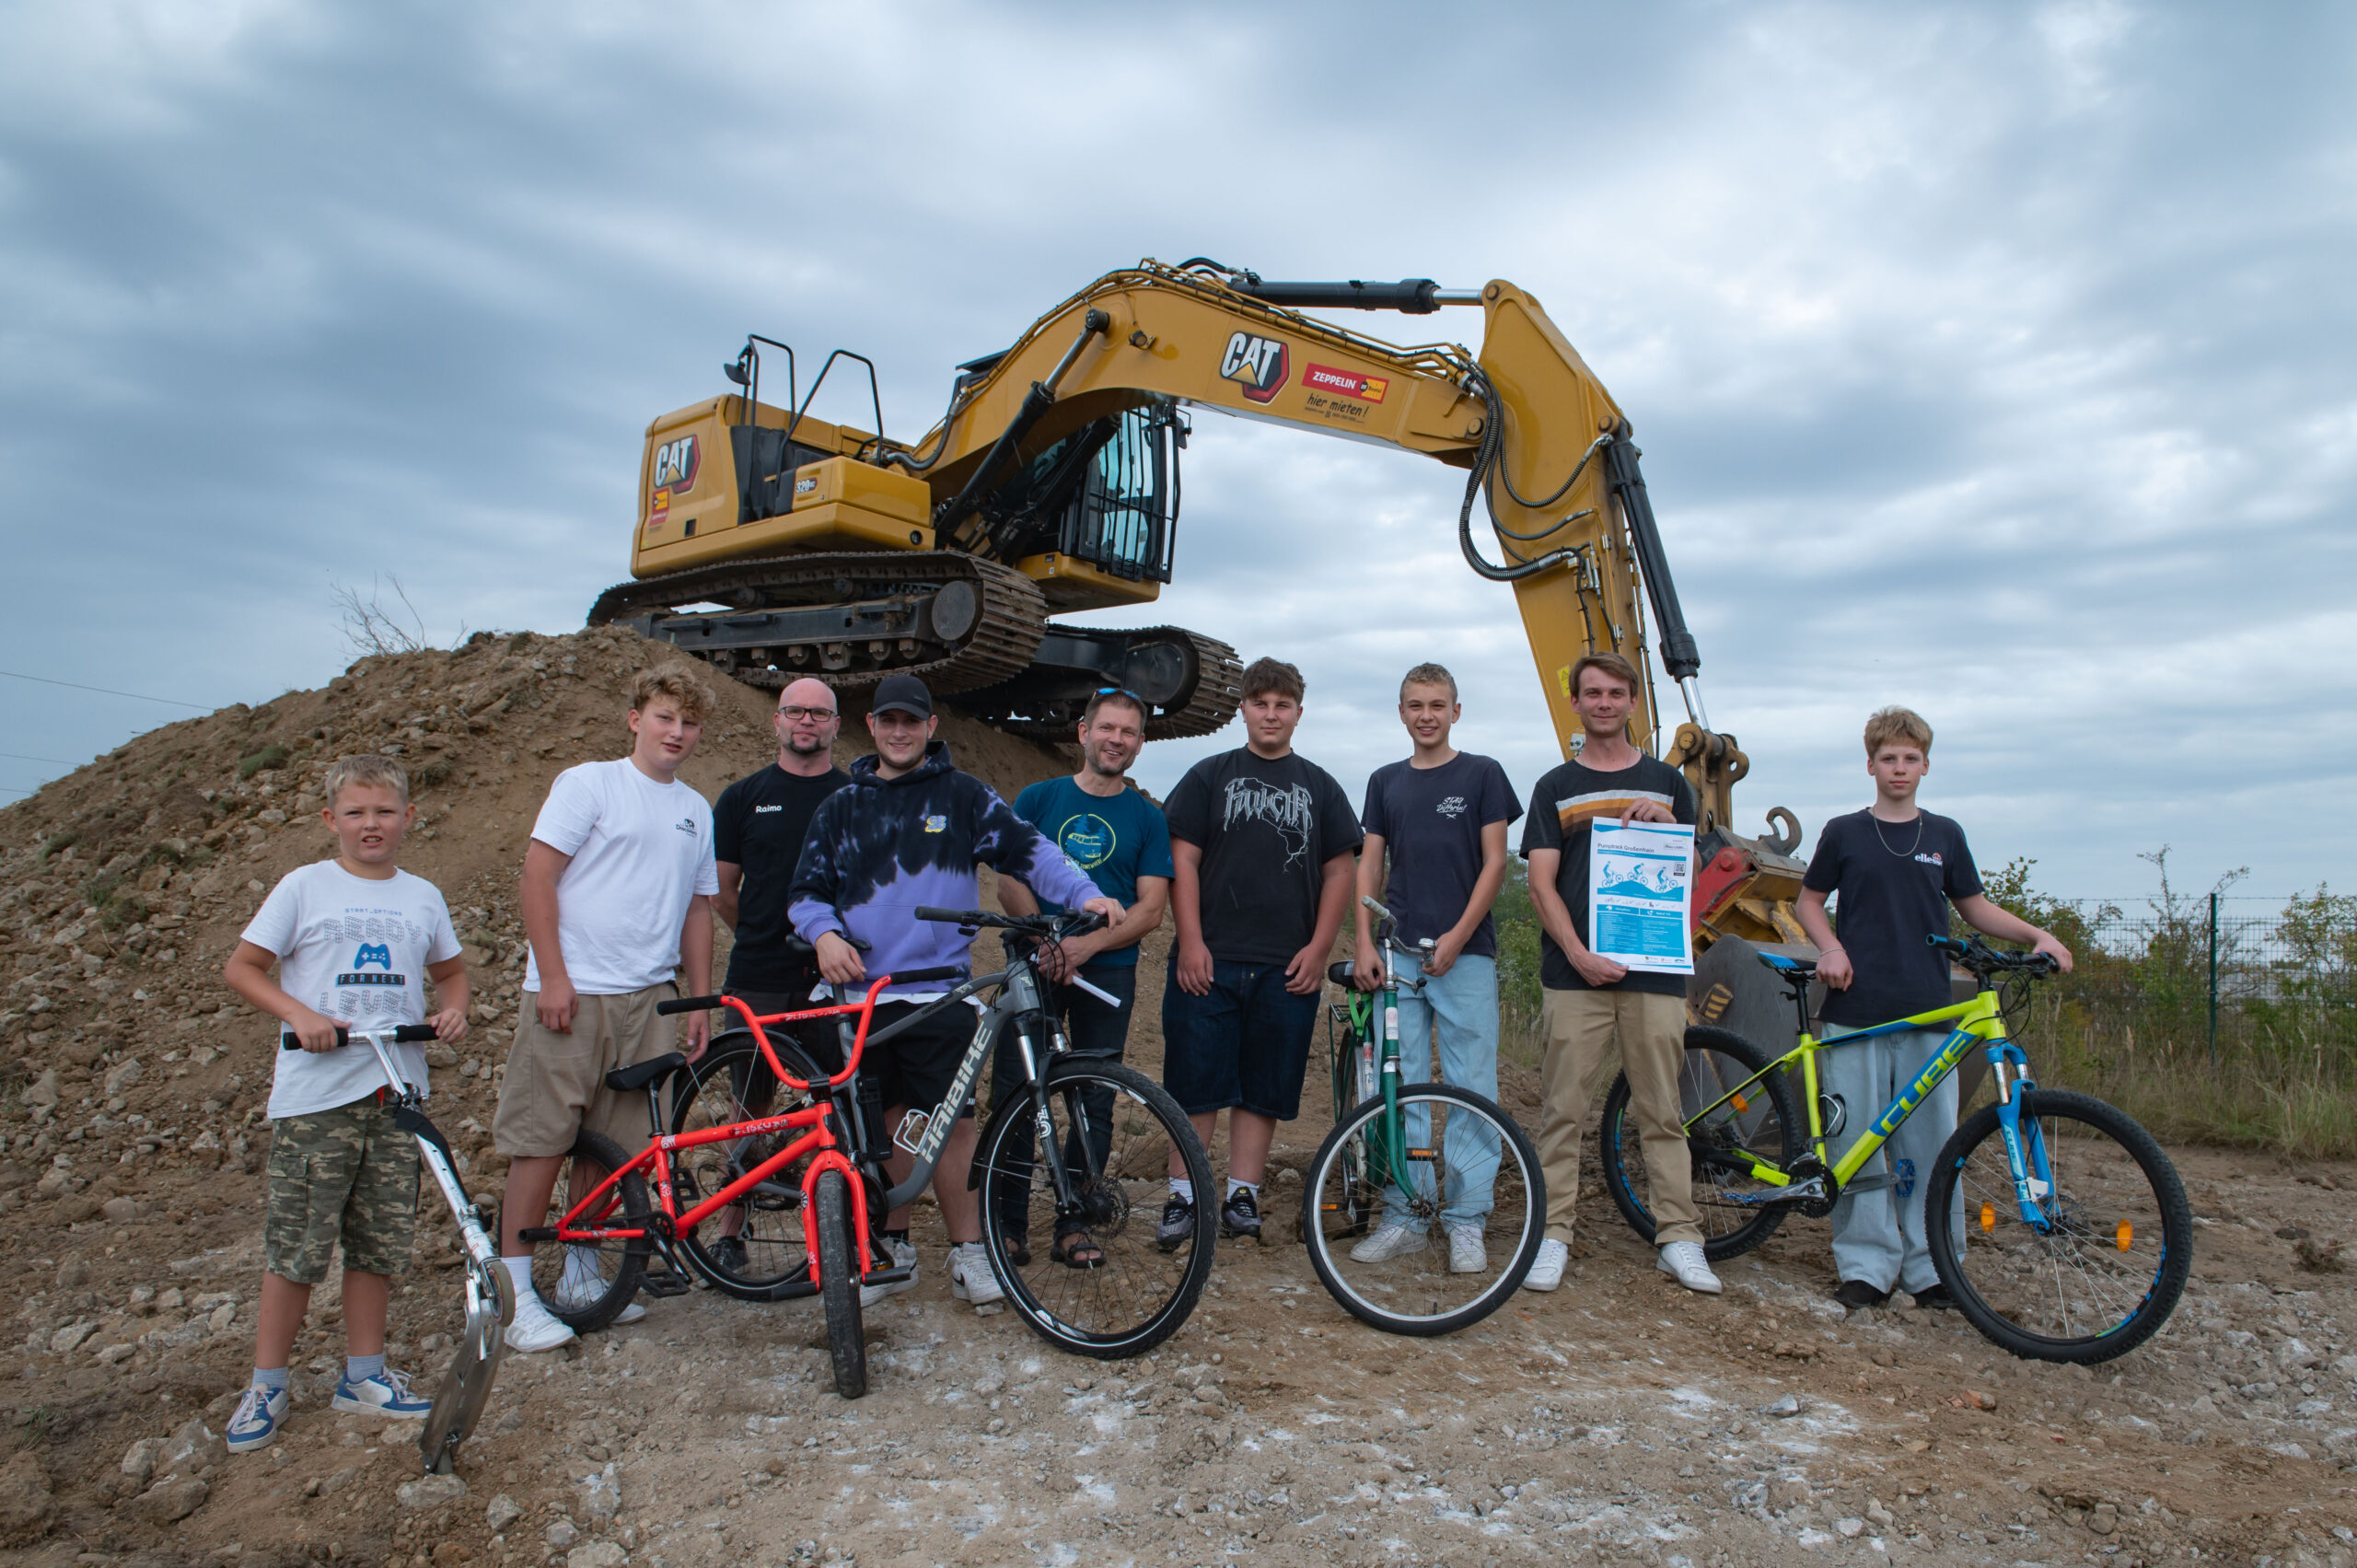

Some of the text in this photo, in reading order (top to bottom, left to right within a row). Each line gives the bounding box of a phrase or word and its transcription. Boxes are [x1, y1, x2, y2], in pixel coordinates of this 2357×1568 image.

[1221, 332, 1281, 388] CAT
[1312, 371, 1357, 389] ZEPPELIN
[1307, 393, 1328, 407] hier
[1329, 400, 1362, 416] mieten
[655, 436, 692, 487] CAT
[796, 480, 809, 494] 320
[755, 805, 782, 813] Raimo
[1597, 842, 1623, 851] Pumptrack
[323, 916, 421, 944] READY
[340, 974, 404, 984] FOR NEXT
[319, 990, 412, 1017] LEVEL
[922, 1021, 993, 1164] HAIBIKE
[1880, 1033, 1967, 1132] CUBE
